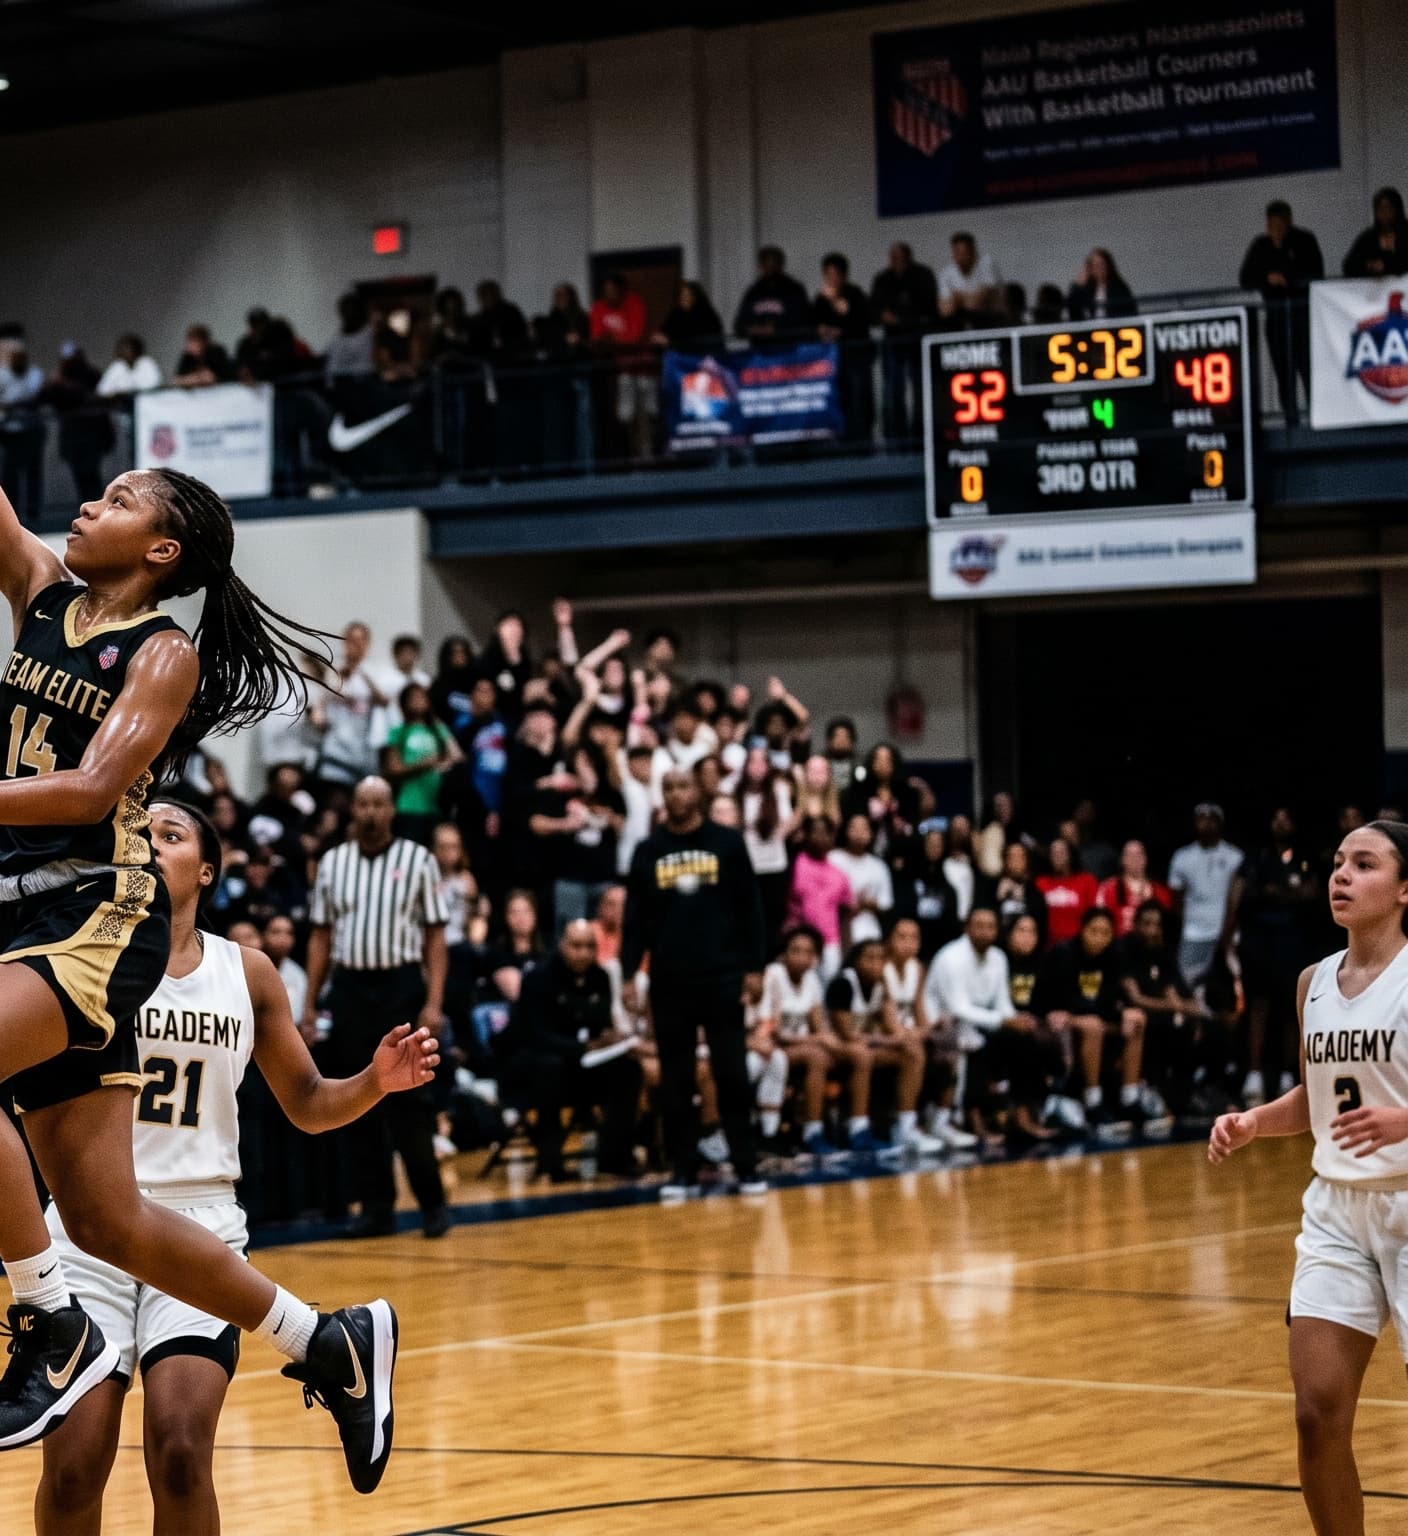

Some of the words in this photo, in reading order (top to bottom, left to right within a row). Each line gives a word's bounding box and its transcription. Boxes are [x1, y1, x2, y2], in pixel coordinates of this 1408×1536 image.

[1034, 57, 1149, 93] Basketball
[1042, 86, 1165, 123] Basketball
[1173, 67, 1317, 106] Tournament
[1156, 321, 1239, 351] VISITOR
[1352, 327, 1408, 369] AA
[951, 370, 1006, 423] 52
[1175, 352, 1232, 403] 48
[1093, 398, 1114, 430] 4
[961, 465, 984, 503] 0
[1090, 460, 1136, 491] QTR
[1203, 449, 1224, 488] 0
[44, 671, 111, 722] ELITE
[5, 703, 57, 778] 14
[138, 1054, 207, 1130] 21
[1334, 1074, 1362, 1116] 2
